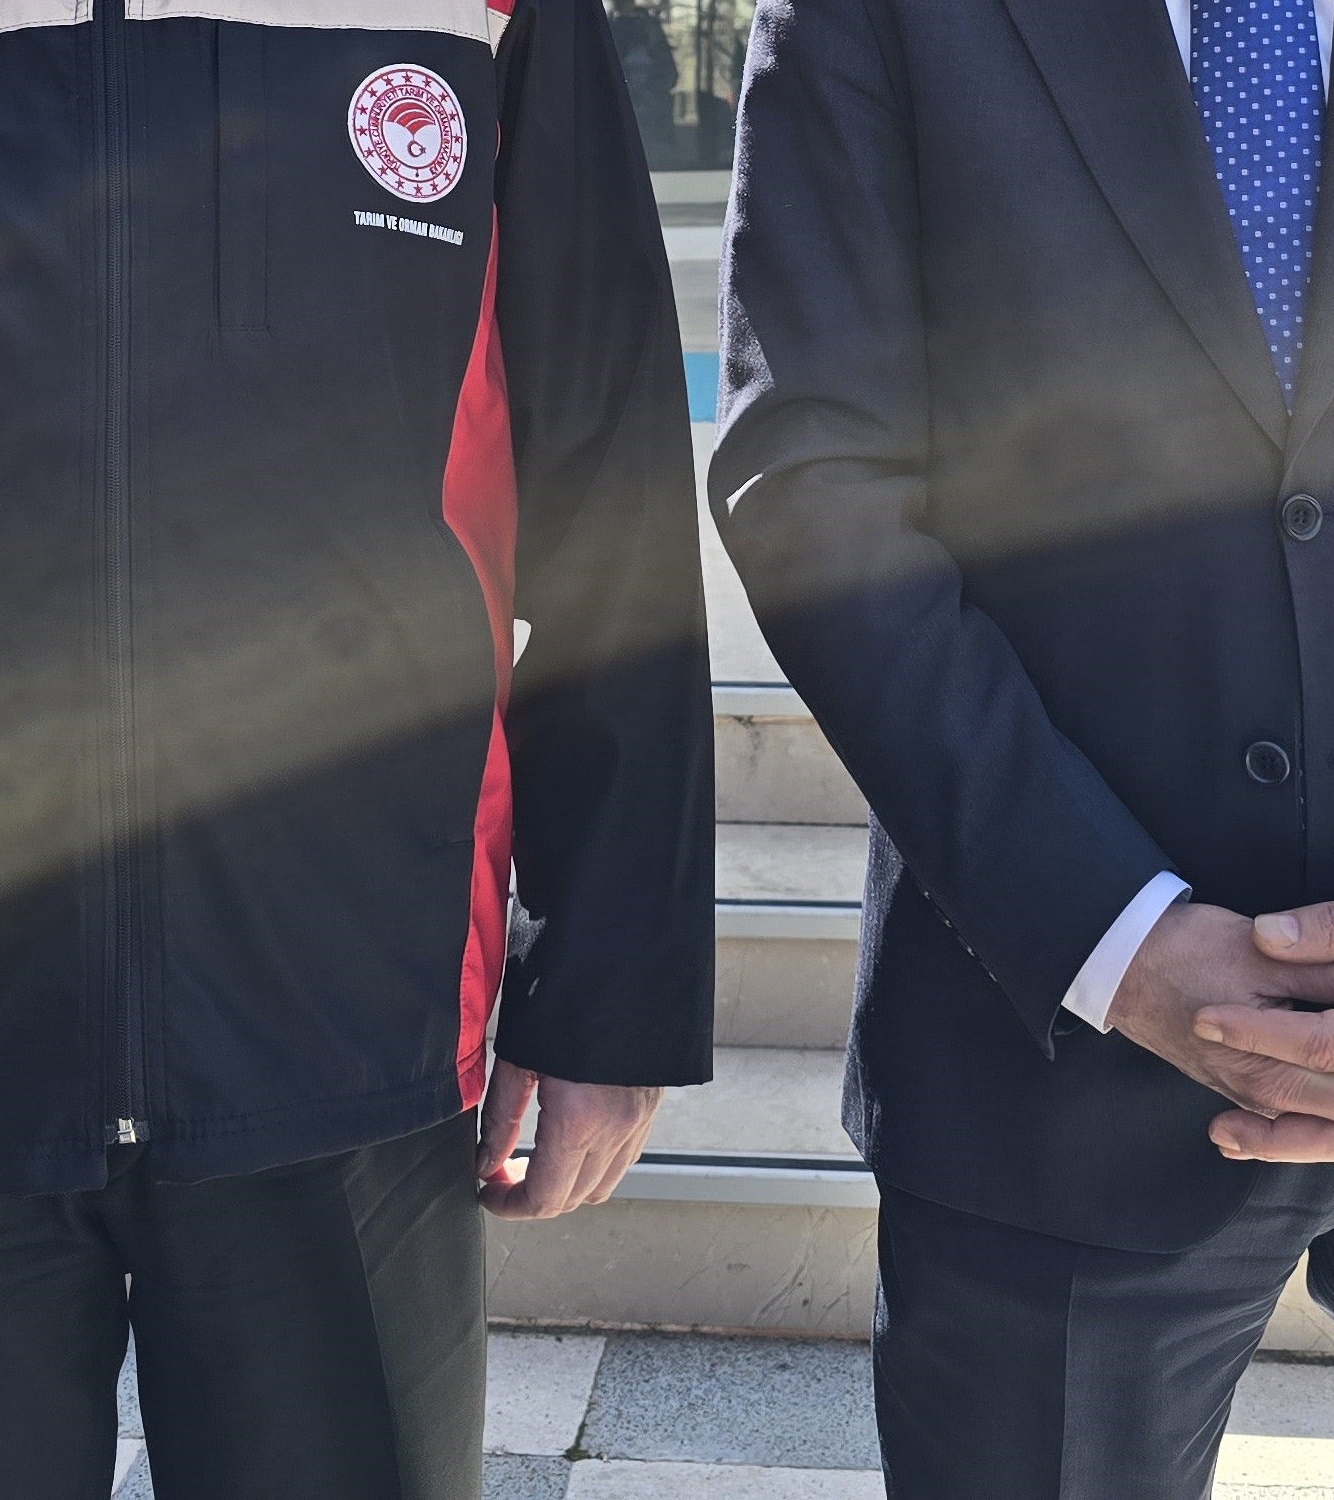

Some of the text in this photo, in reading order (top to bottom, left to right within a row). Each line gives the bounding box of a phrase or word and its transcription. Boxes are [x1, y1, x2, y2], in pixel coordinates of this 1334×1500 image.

[353, 210, 385, 228] TARIM
[386, 215, 397, 231] VE
[399, 218, 428, 237] ORMAN
